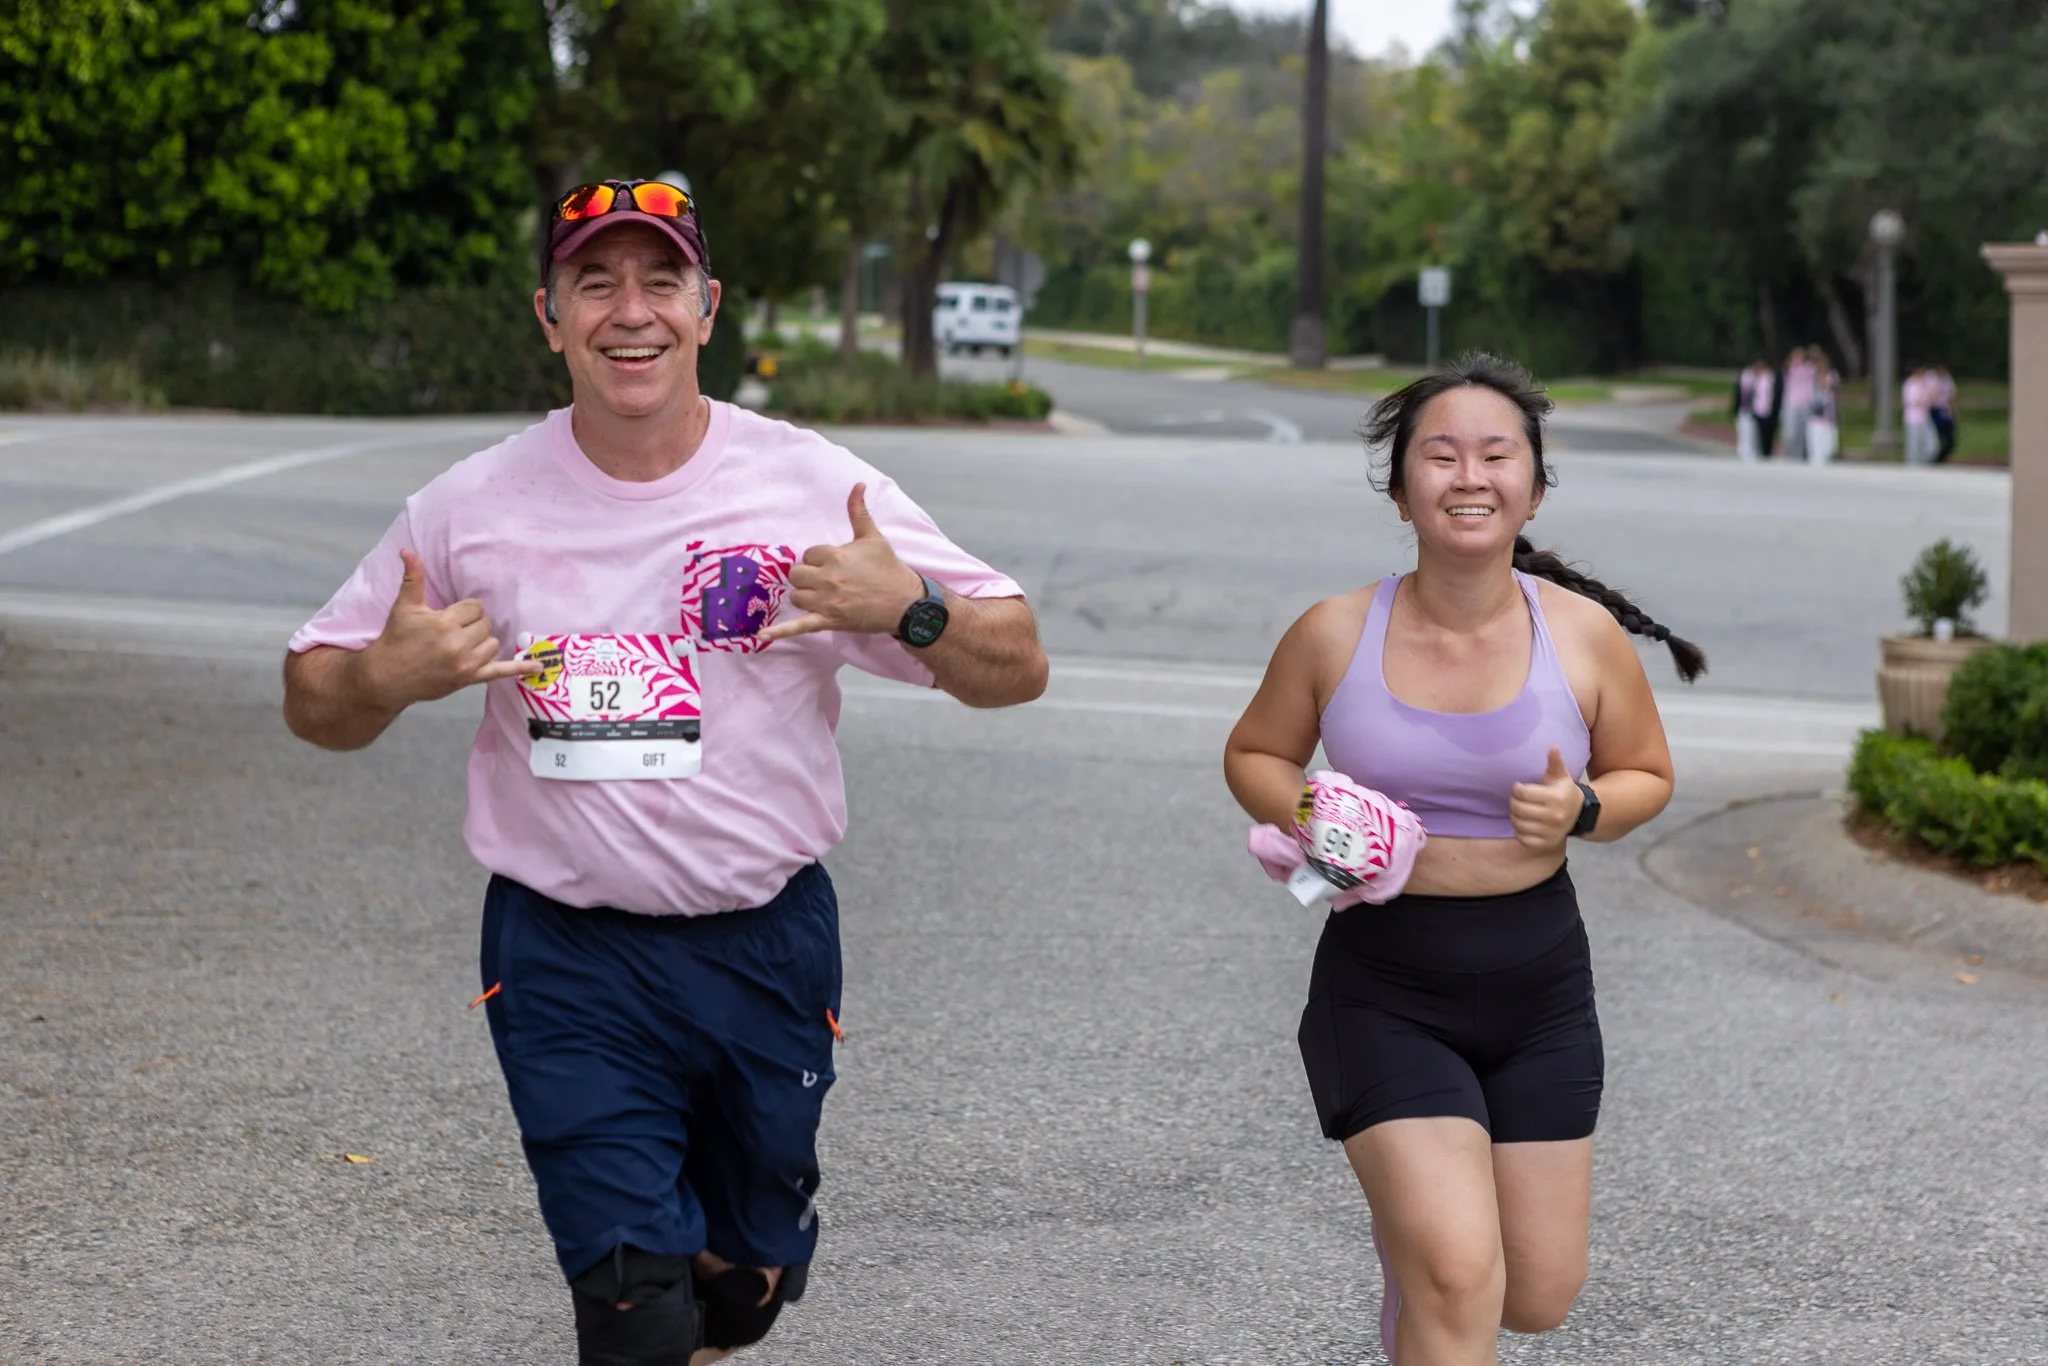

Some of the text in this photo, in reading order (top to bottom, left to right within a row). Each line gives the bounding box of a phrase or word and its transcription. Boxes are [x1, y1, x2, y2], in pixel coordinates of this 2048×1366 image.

[590, 681, 620, 710] 52
[554, 752, 666, 768] 52 GIFT
